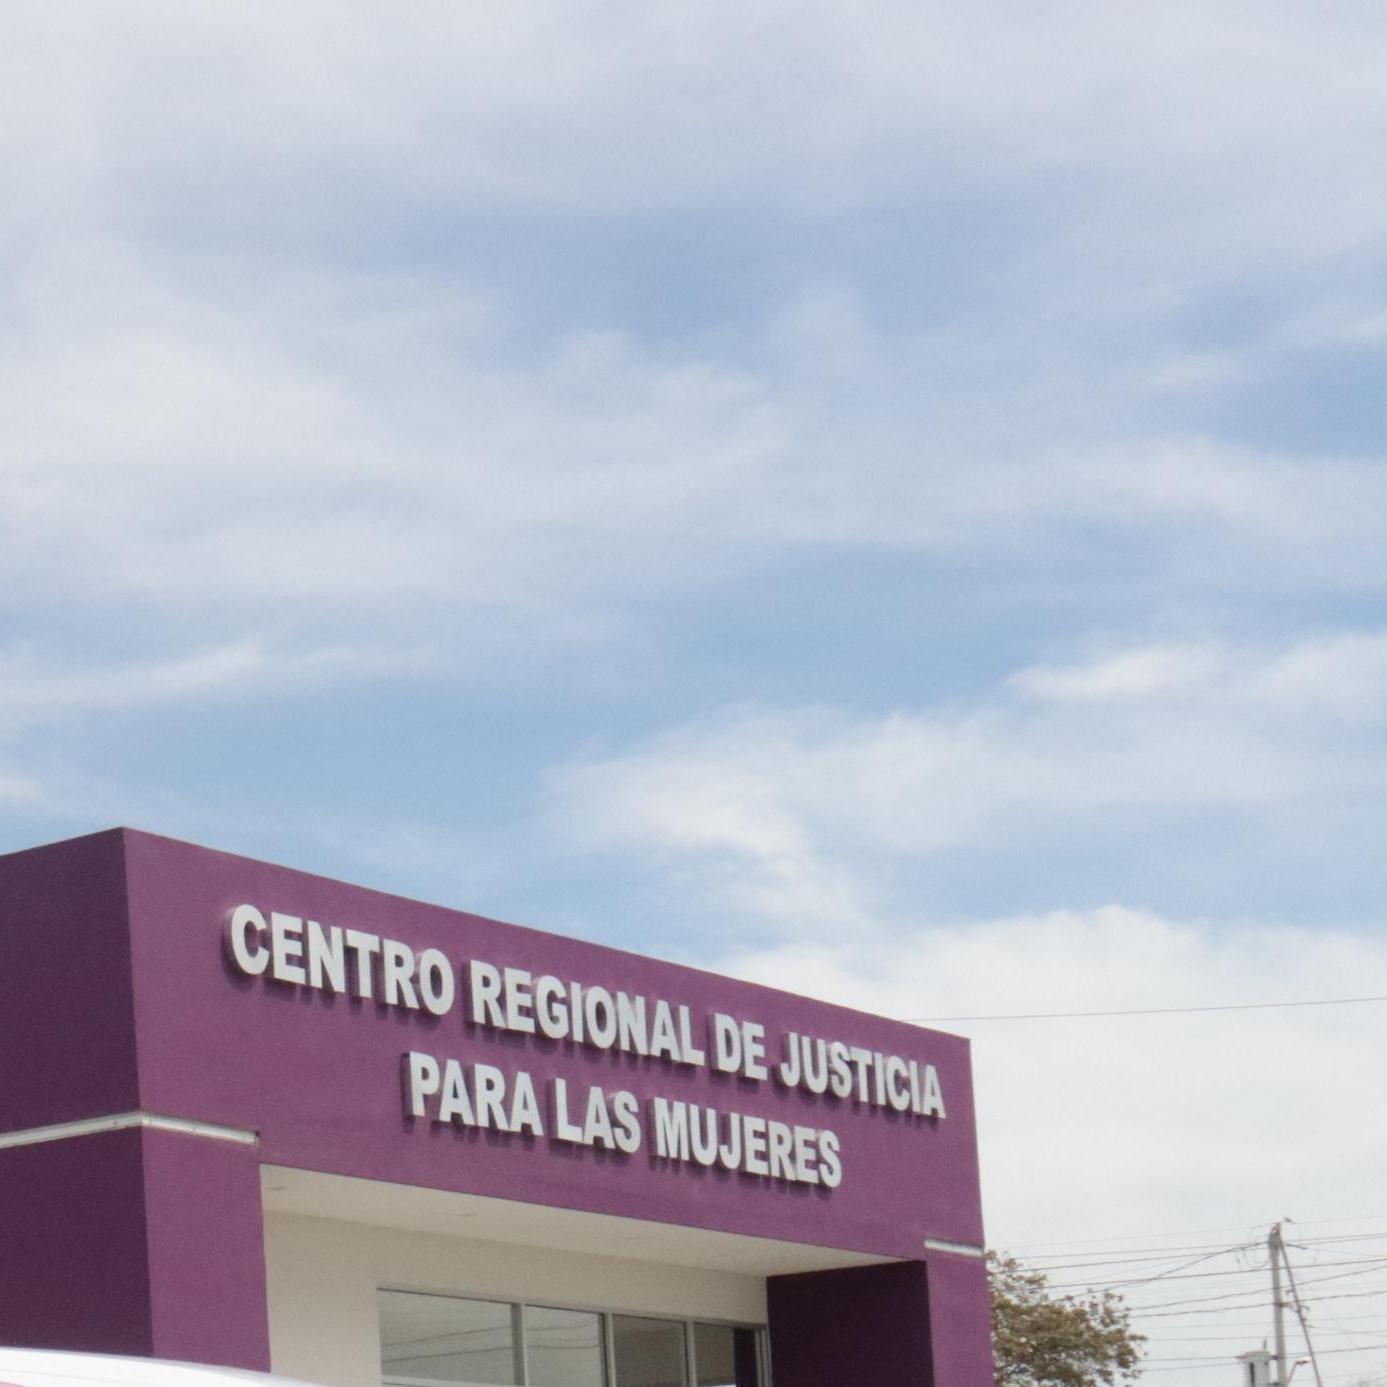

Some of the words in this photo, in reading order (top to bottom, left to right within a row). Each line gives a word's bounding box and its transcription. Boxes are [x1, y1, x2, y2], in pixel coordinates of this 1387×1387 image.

[229, 903, 456, 1016] CENTRO
[470, 959, 705, 1068] REGIONAL
[714, 1011, 768, 1082] DE
[778, 1030, 947, 1120] JUSTICIA
[407, 1052, 543, 1137] PARA
[554, 1077, 641, 1155] LAS
[652, 1096, 843, 1189] MUJERES
